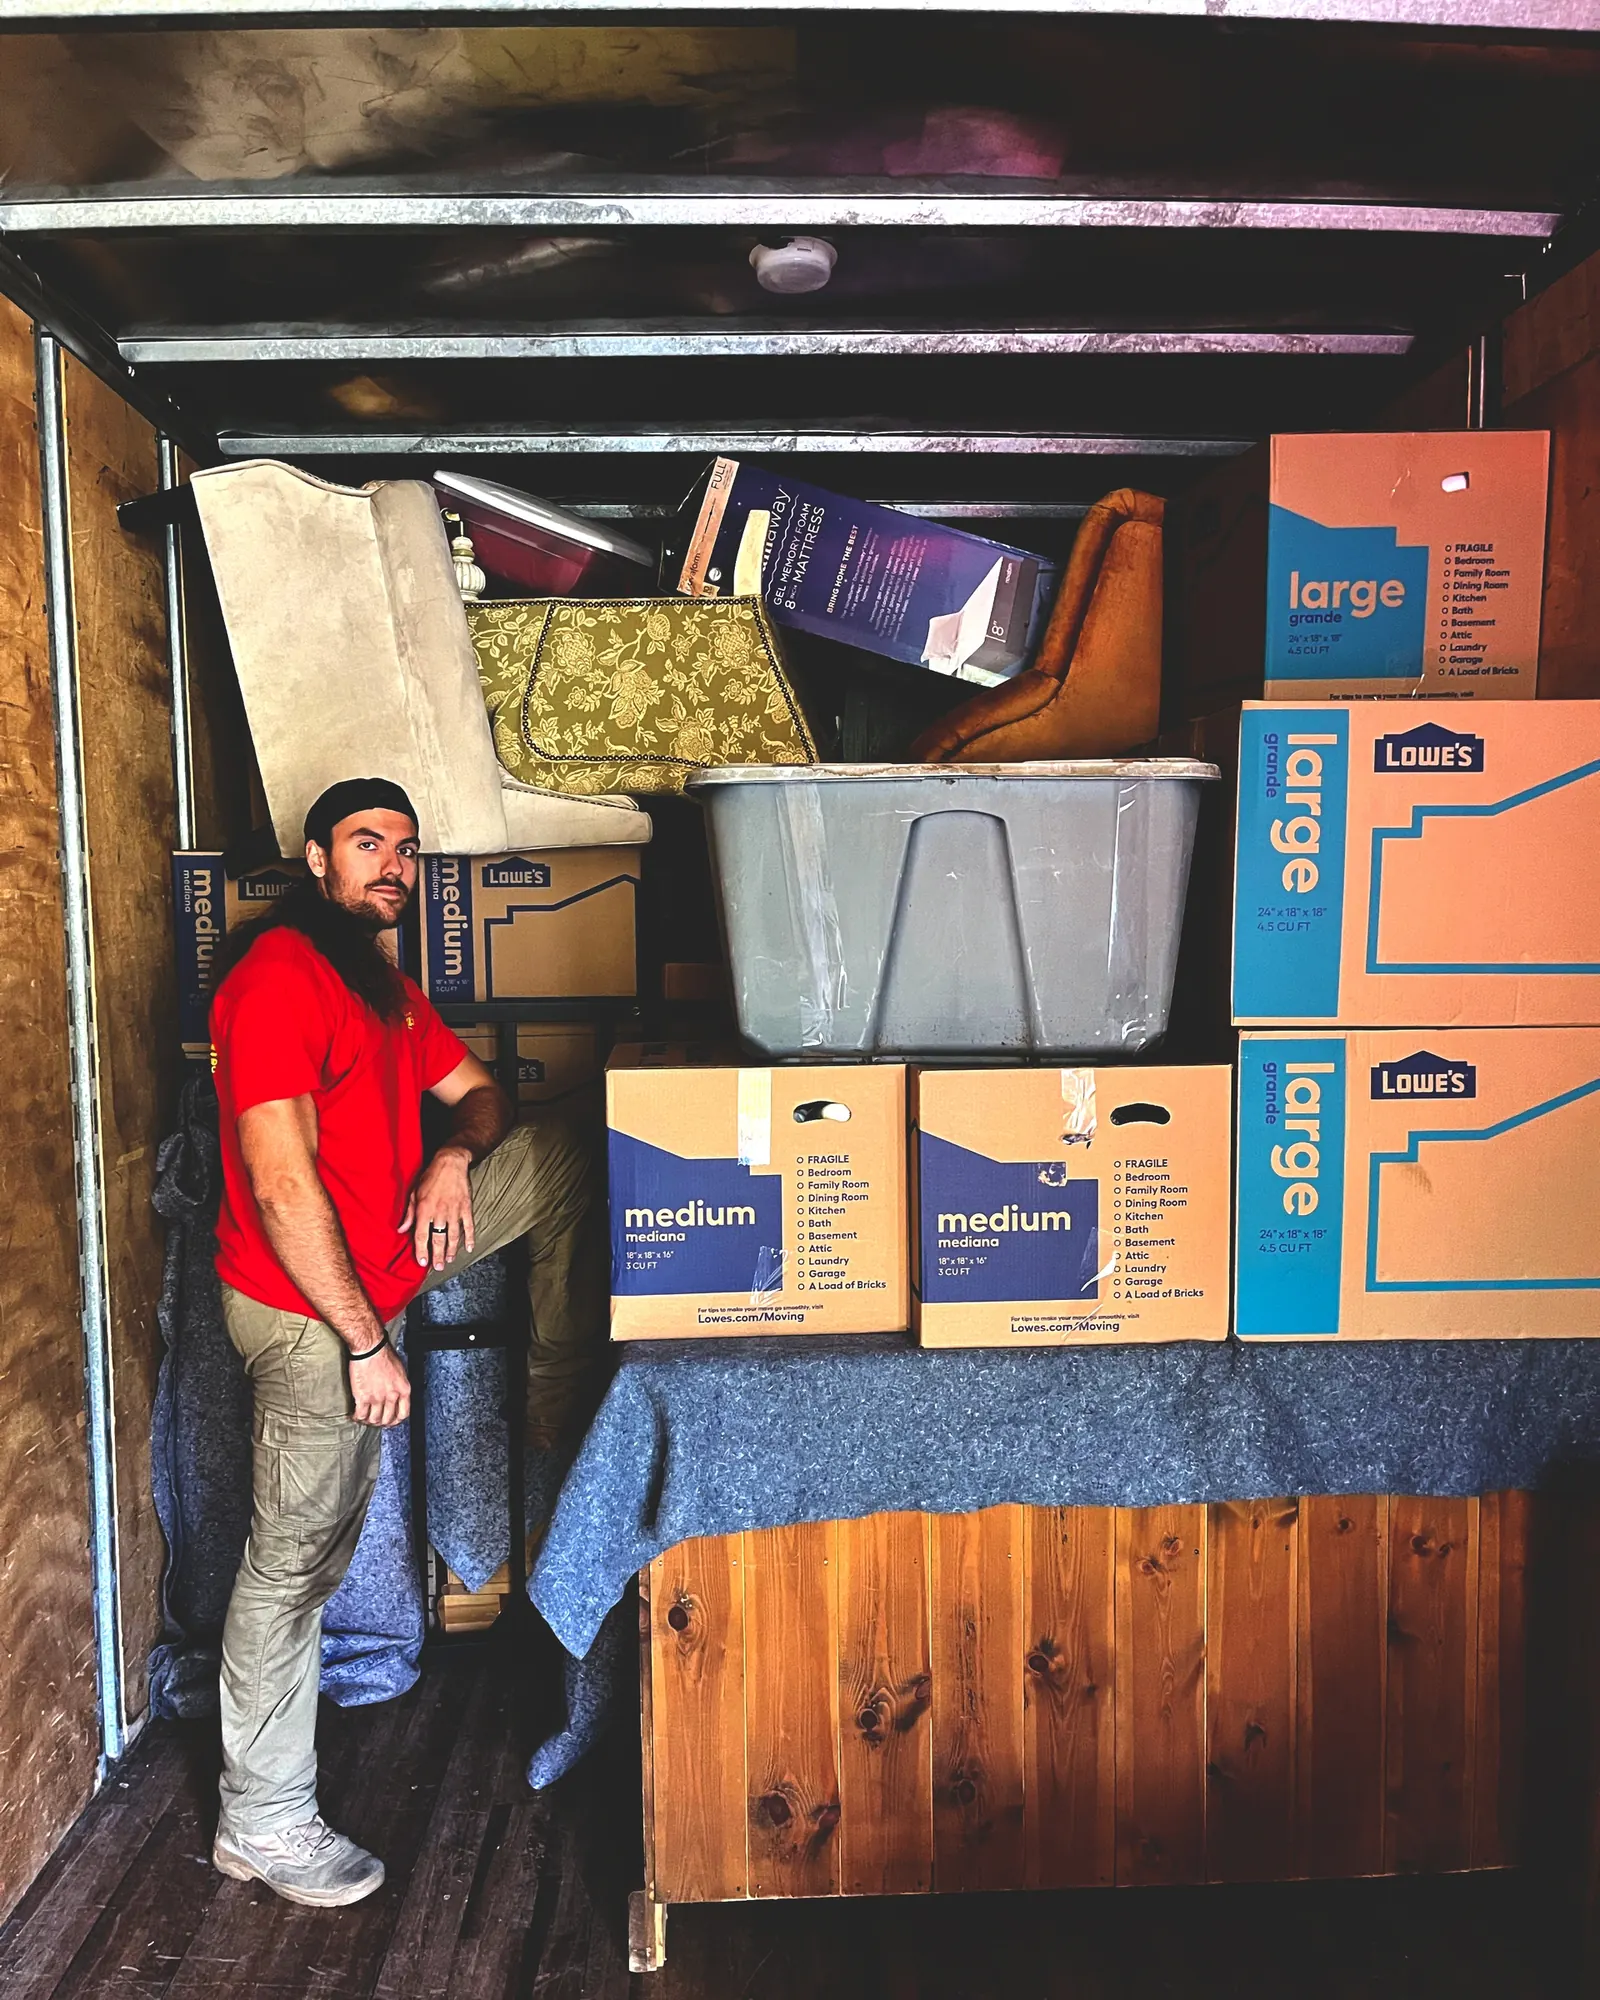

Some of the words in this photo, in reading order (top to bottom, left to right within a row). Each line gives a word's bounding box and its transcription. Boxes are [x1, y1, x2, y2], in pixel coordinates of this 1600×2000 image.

[711, 463, 727, 490] FULL
[849, 524, 859, 545] BEST
[842, 542, 853, 561] THE
[1456, 544, 1493, 553] FRAGILE
[774, 585, 786, 606] GEL
[780, 534, 800, 584] MEMORY
[795, 502, 811, 533] FOAM
[785, 600, 796, 610] 8
[793, 506, 825, 582] MATTRESS
[1455, 557, 1495, 565] Bedroom
[833, 560, 848, 587] HOME
[1454, 569, 1483, 579] Family
[1485, 569, 1510, 577] Room
[1453, 581, 1482, 591] Dining
[1484, 581, 1508, 590] Room
[1290, 571, 1405, 618] large
[1453, 594, 1487, 602] Kitchen
[827, 588, 840, 614] BRING
[1452, 606, 1473, 615] Bath
[1290, 612, 1342, 627] grande
[1451, 618, 1495, 627] Basement
[1451, 631, 1472, 639] Attic
[1288, 646, 1302, 655] 4.5
[1303, 646, 1317, 654] CU
[1318, 646, 1329, 654] FT
[1450, 643, 1487, 654] Laundry
[1449, 656, 1483, 666] Garage
[1449, 668, 1455, 676] A
[1457, 668, 1481, 676] Load
[1482, 667, 1491, 676] of
[1493, 667, 1519, 676] Bricks
[1386, 743, 1472, 767] LOWE'S
[1264, 734, 1281, 798] grande
[1270, 734, 1338, 893] large
[490, 869, 544, 884] LOWE'S
[183, 869, 191, 913] mediana
[442, 858, 469, 976] medium
[1258, 908, 1276, 917] 24"
[1285, 908, 1300, 917] 18"
[1311, 907, 1327, 917] 18"
[1257, 922, 1274, 932] 4.5
[1277, 922, 1295, 932] CU
[1297, 922, 1311, 931] FT
[1382, 1069, 1465, 1094] LOWE'S
[1263, 1062, 1280, 1124] grande
[1270, 1062, 1335, 1216] large
[808, 1155, 849, 1164] FRAGILE
[1125, 1159, 1168, 1168] FRAGILE
[808, 1168, 851, 1177] Bedroom
[1125, 1172, 1170, 1181] Bedroom
[808, 1180, 839, 1190] Family
[842, 1180, 869, 1189] Room
[1125, 1185, 1158, 1195] Family
[1161, 1185, 1188, 1194] Room
[808, 1193, 839, 1203] Dining
[841, 1193, 869, 1201] Room
[1125, 1198, 1157, 1208] Dining
[1159, 1198, 1187, 1207] Room
[625, 1200, 755, 1228] medium
[808, 1206, 845, 1215] Kitchen
[938, 1205, 1071, 1232] medium
[1125, 1212, 1163, 1221] Kitchen
[809, 1219, 832, 1228] Bath
[1125, 1225, 1149, 1234] Bath
[1259, 1229, 1277, 1239] 24"
[1286, 1229, 1301, 1239] 18"
[1312, 1229, 1327, 1239] 18"
[626, 1231, 685, 1242] mediana
[809, 1231, 857, 1240] Basement
[938, 1237, 999, 1248] mediana
[1125, 1238, 1175, 1247] Basement
[809, 1244, 832, 1253] Attic
[1259, 1243, 1276, 1253] 4.5
[1279, 1243, 1296, 1253] CU
[1298, 1243, 1312, 1252] FT
[644, 1251, 655, 1259] 18"
[663, 1251, 674, 1259] 16"
[1125, 1251, 1149, 1260] Attic
[809, 1257, 849, 1266] Laundry
[938, 1257, 950, 1265] 18"
[957, 1257, 968, 1265] 18"
[976, 1256, 988, 1264] 16"
[626, 1262, 631, 1270] 3
[632, 1262, 645, 1270] CU
[1125, 1264, 1166, 1274] Laundry
[809, 1269, 845, 1279] Garage
[938, 1268, 943, 1276] 3
[945, 1268, 958, 1276] CU
[959, 1268, 970, 1276] FT
[809, 1282, 816, 1290] A
[818, 1281, 843, 1290] Load
[845, 1281, 855, 1289] of
[857, 1280, 886, 1289] Bricks
[1125, 1277, 1163, 1287] Garage
[1125, 1290, 1132, 1299] A
[1135, 1290, 1159, 1299] Load
[1162, 1290, 1172, 1298] of
[1175, 1289, 1204, 1298] Bricks
[698, 1311, 804, 1323] Lowes.com/Moving
[1011, 1321, 1120, 1333] Lowes.com/Moving
